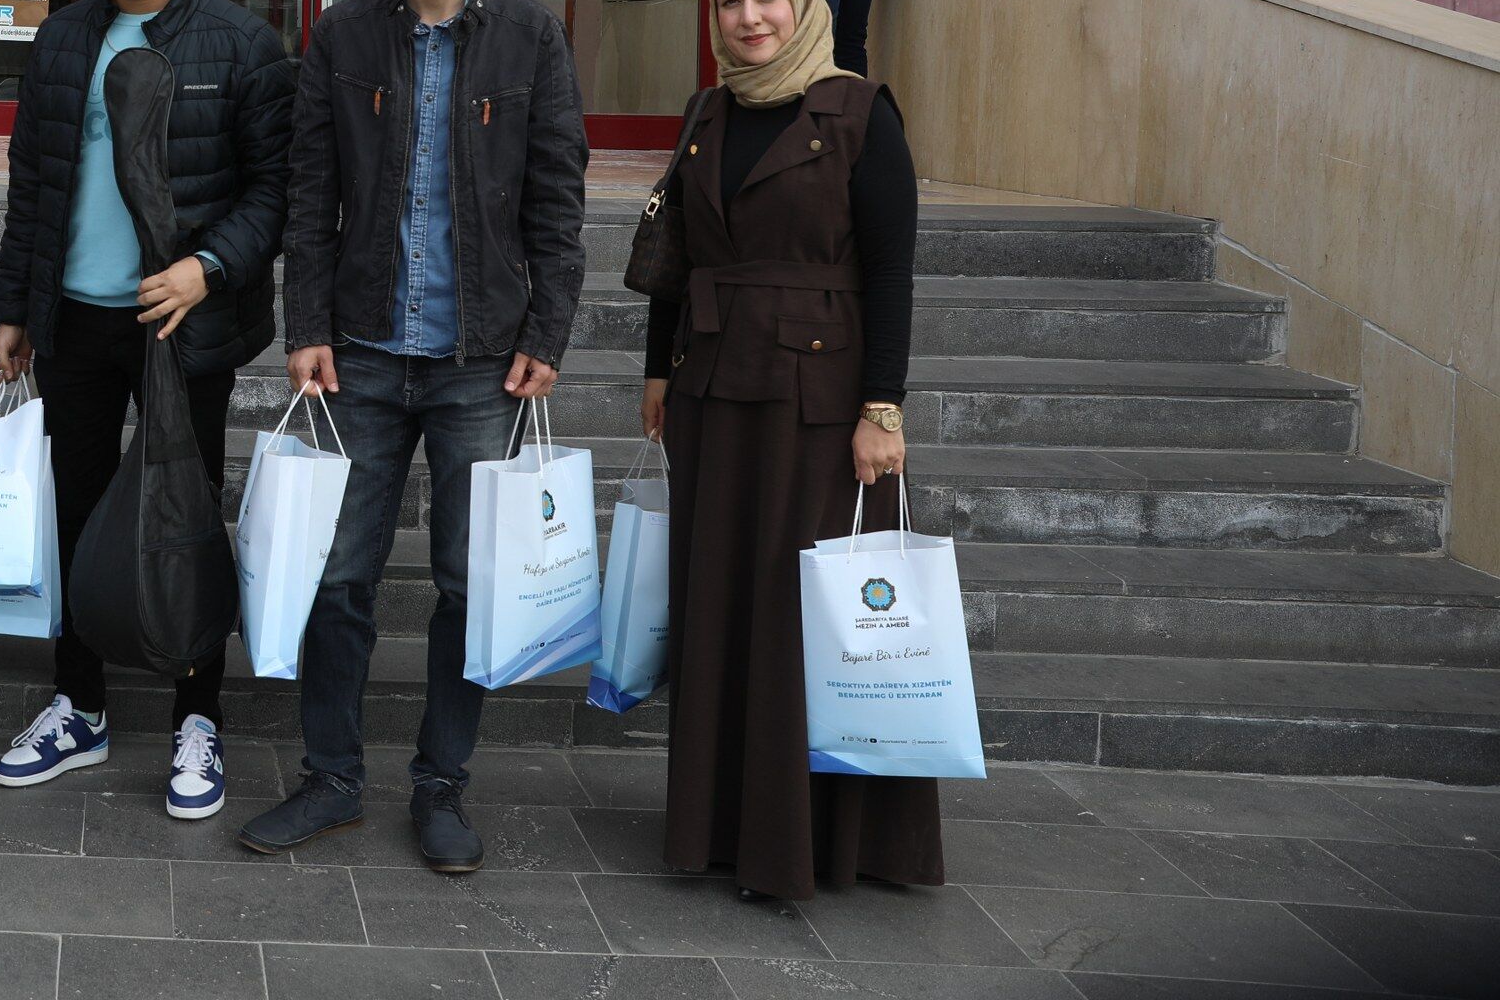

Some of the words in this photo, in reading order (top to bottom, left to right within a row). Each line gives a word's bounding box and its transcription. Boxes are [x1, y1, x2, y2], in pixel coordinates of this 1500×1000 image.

[841, 651, 873, 664] Bajarê
[826, 680, 871, 689] SEROKTIYA
[911, 679, 952, 688] XIZMETÊN
[838, 691, 886, 699] BERASTENG
[888, 691, 894, 699] Û
[897, 691, 943, 699] EXTIYARAN
